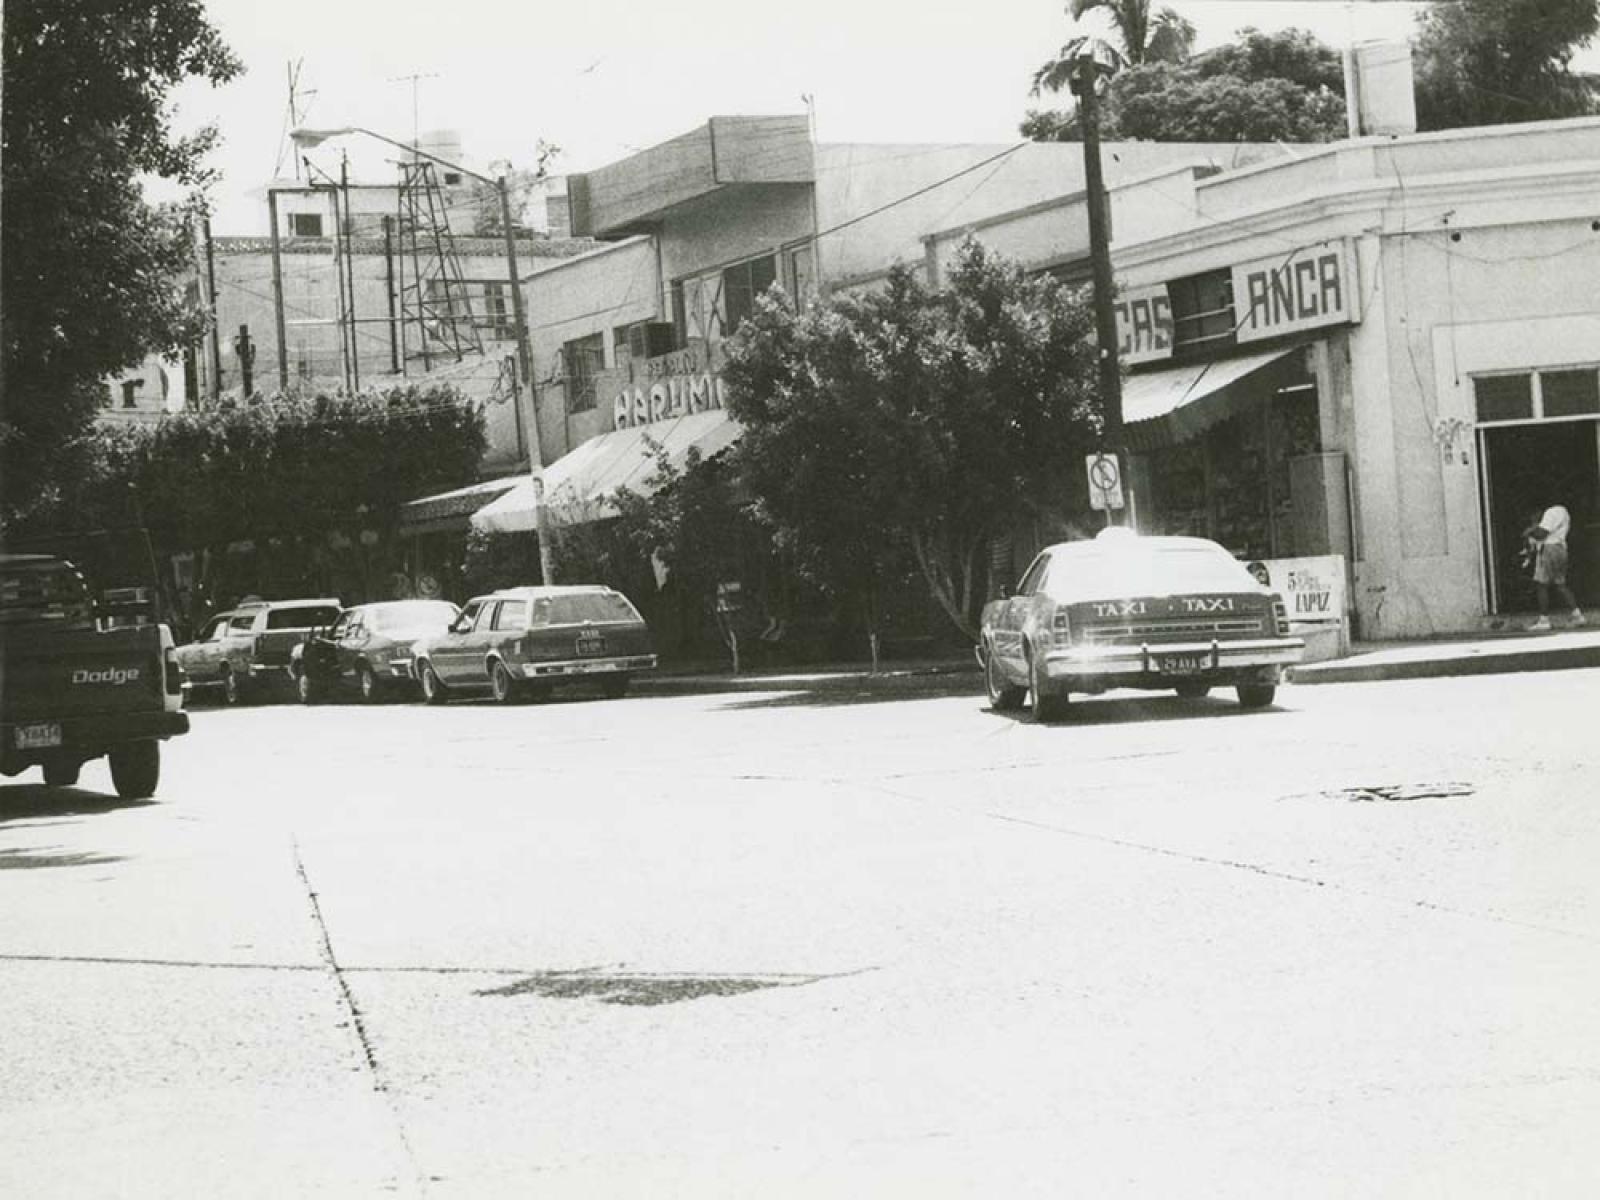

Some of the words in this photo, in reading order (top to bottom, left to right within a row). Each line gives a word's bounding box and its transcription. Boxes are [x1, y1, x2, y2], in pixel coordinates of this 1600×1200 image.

[1248, 253, 1341, 329] ANCA
[1092, 602, 1146, 617] TAXI
[1182, 598, 1234, 611] TAXI
[72, 666, 139, 686] Dodge
